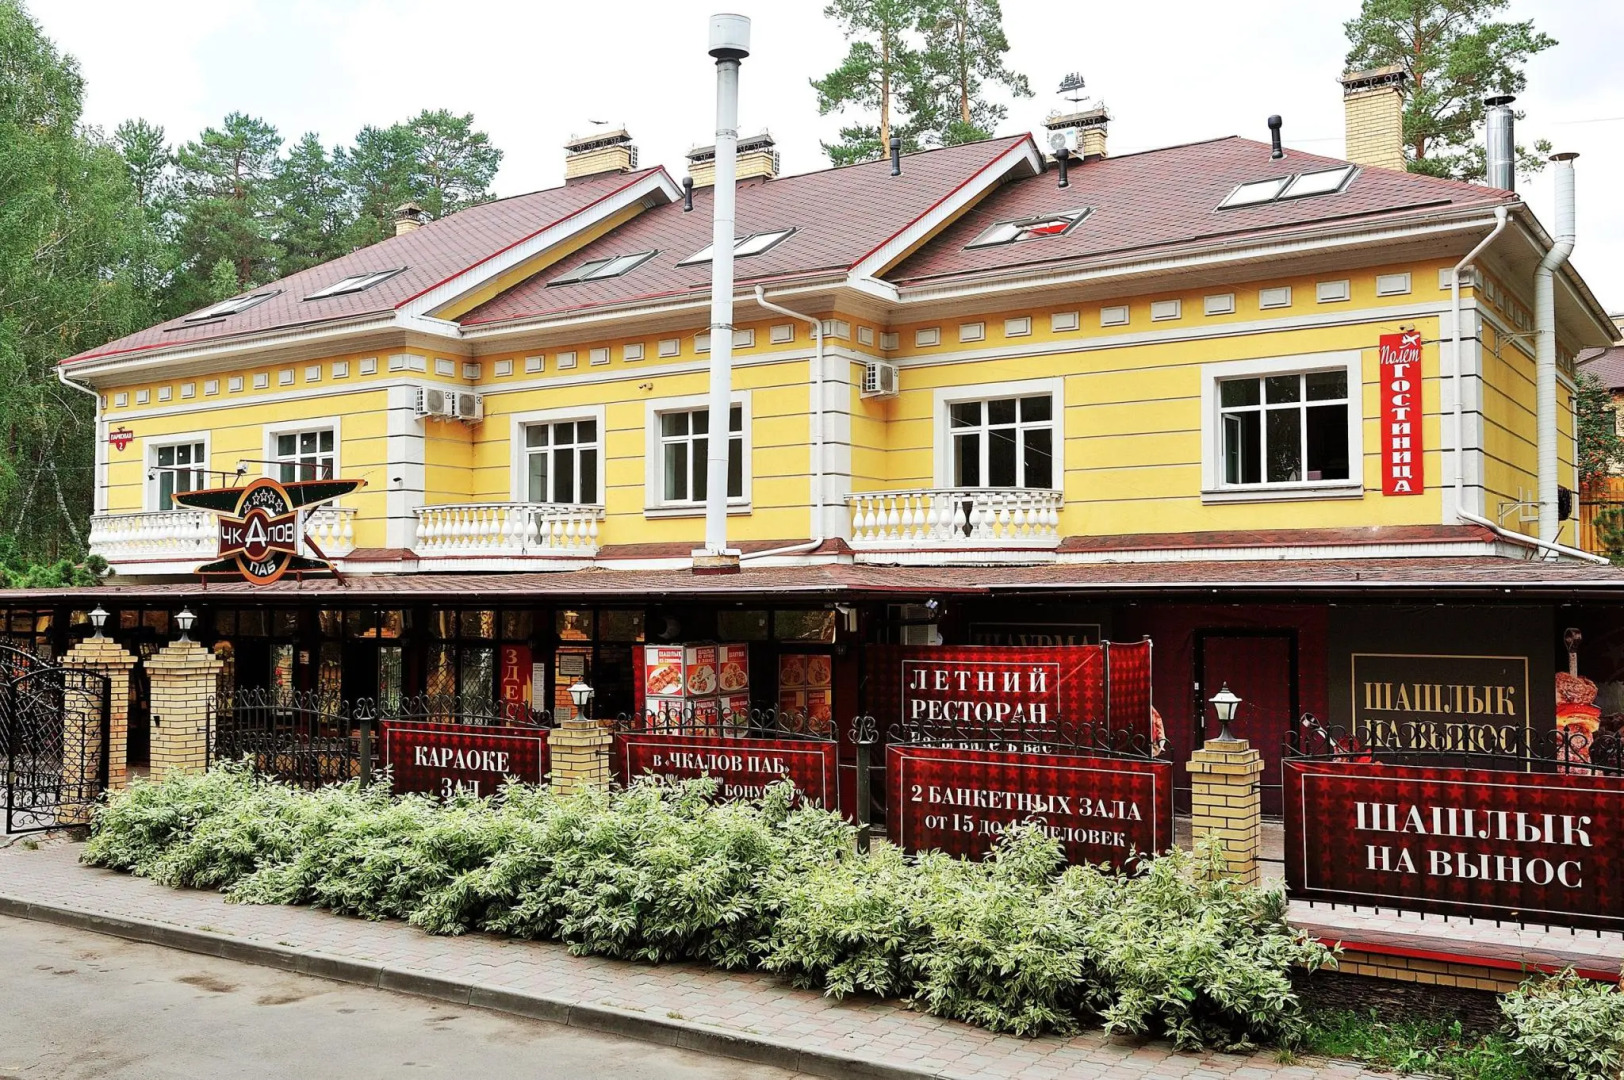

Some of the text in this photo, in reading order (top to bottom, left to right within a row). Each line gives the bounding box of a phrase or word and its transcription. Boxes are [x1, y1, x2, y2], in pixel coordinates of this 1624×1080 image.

[1380, 345, 1421, 365] Полет
[1390, 363, 1413, 493] ГОСТИНИЦА
[118, 441, 124, 450] 2
[221, 516, 295, 548] ЧКАЛОВ
[249, 559, 277, 576] ПАБ
[910, 667, 1048, 694] ЛЕТНИЙ
[910, 699, 1048, 725] РЕСТОРАН
[1364, 682, 1516, 716] ШАШЛЫК
[1364, 719, 1518, 754] НА ВЫНОС
[414, 746, 510, 772] КАРАОКЕ
[911, 784, 1143, 822] 2 БАНКЕТНЫХ ЗАЛА
[953, 813, 974, 833] 15
[1354, 801, 1593, 847] ШАШЛЫК
[1366, 845, 1583, 889] НА ВЫНОС
